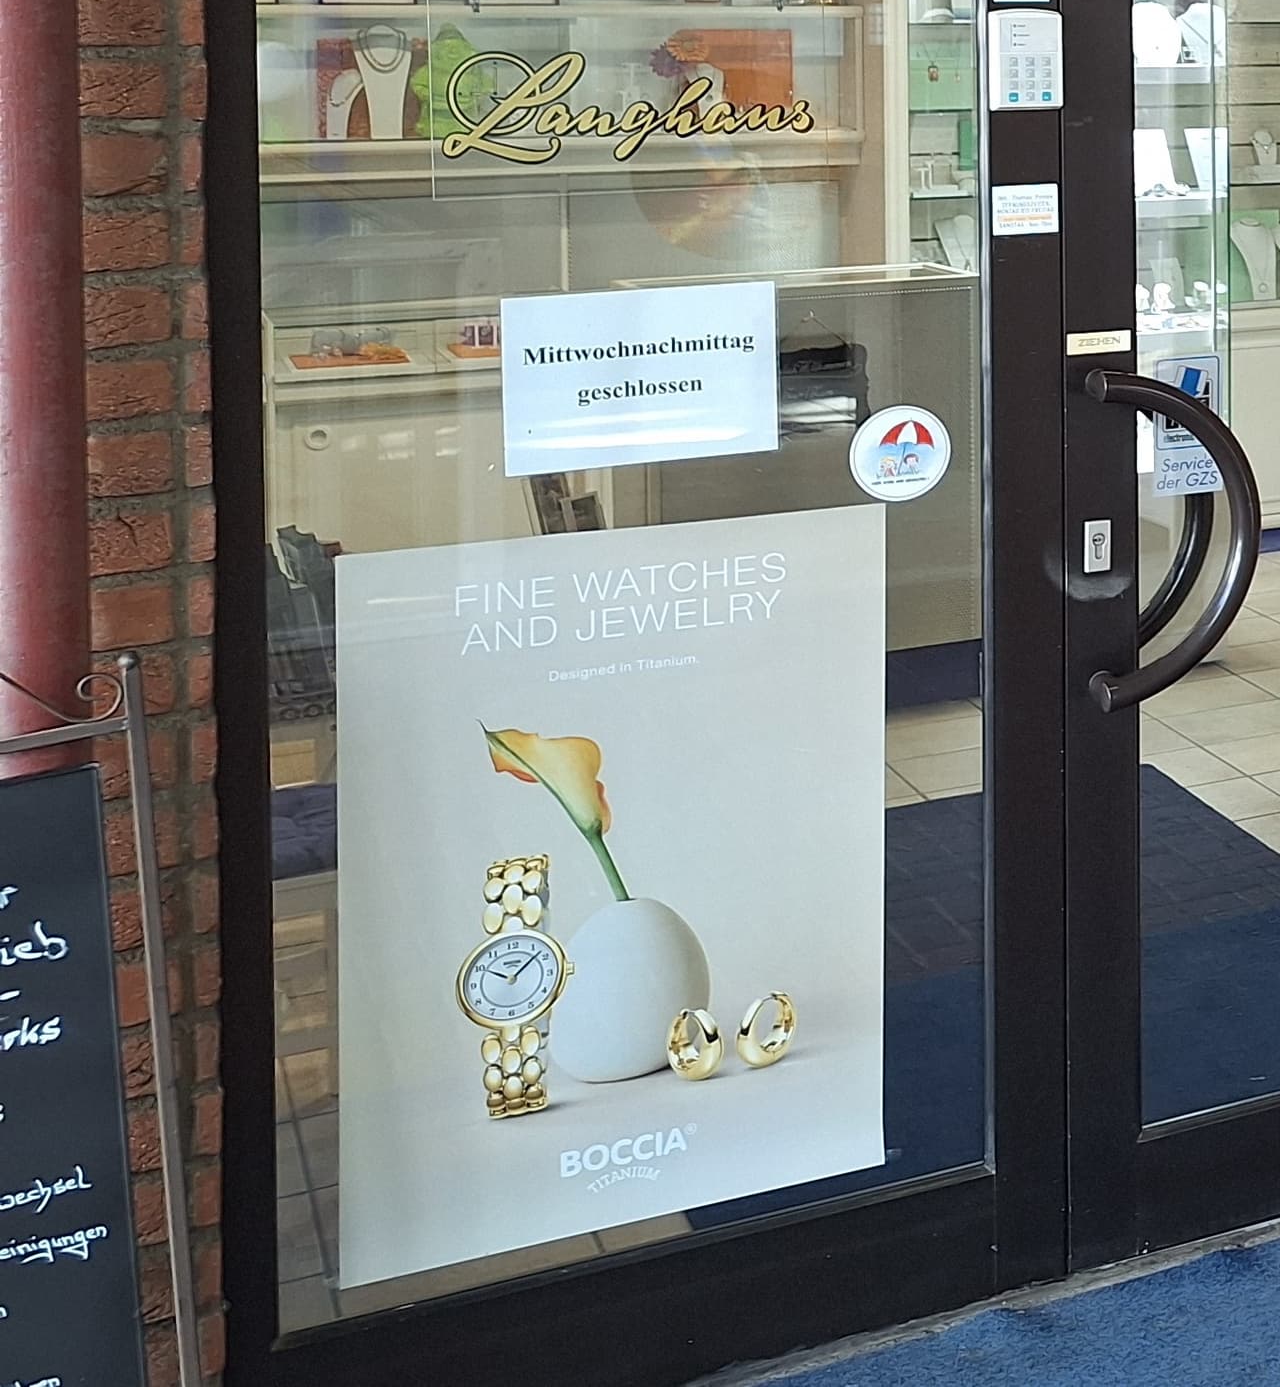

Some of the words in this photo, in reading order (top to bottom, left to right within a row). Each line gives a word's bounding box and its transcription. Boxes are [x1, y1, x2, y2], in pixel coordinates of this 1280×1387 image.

[523, 334, 755, 366] Mittwochnachmittag
[1077, 335, 1121, 347] ZIEHEN
[577, 378, 702, 406] geschlossen
[1161, 455, 1213, 473] Service
[1156, 474, 1181, 490] der
[1185, 470, 1218, 487] GZS
[455, 575, 555, 617] FINE
[572, 552, 787, 603] WATCHES
[461, 615, 558, 656] AND
[575, 588, 782, 642] JEWELRY
[548, 663, 616, 683] Designed
[619, 661, 632, 673] in
[636, 653, 699, 671] Titanium.
[0, 1016, 61, 1051] rks
[560, 1127, 688, 1178] BOCCIA
[587, 1165, 661, 1194] TITANIUM
